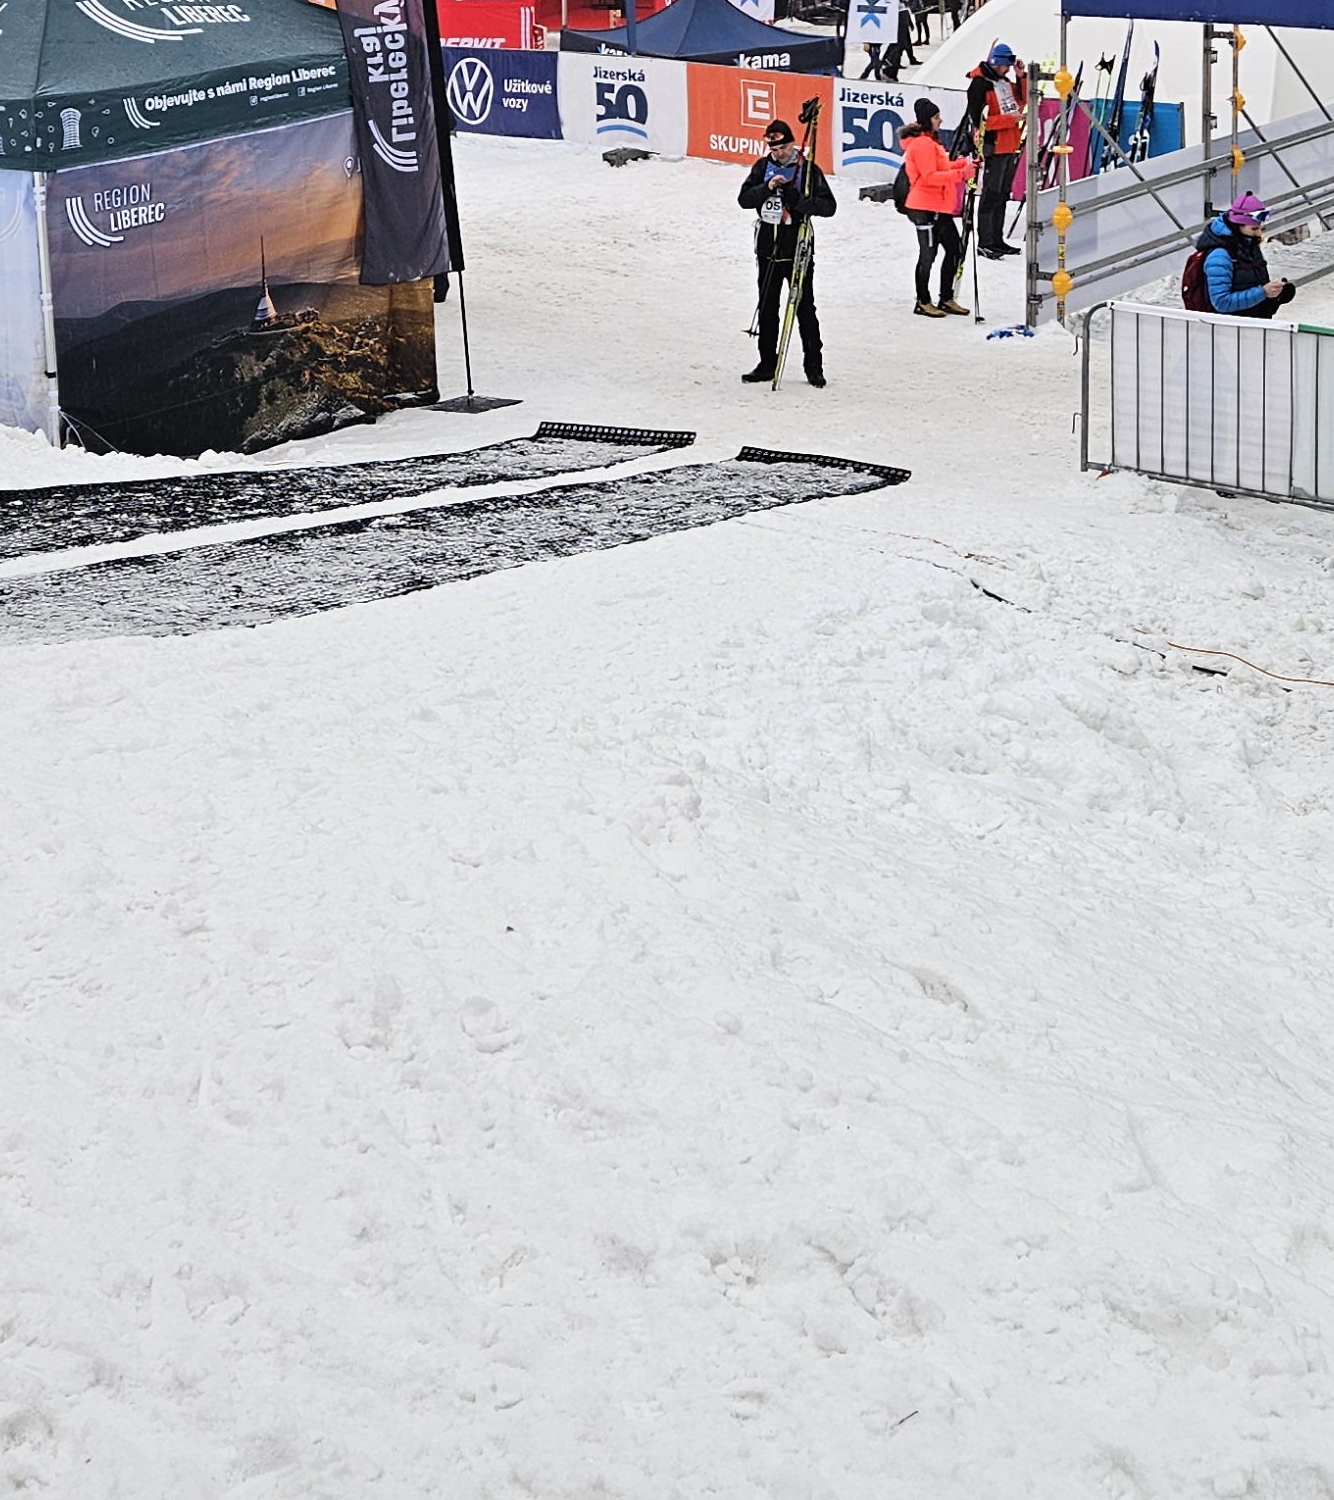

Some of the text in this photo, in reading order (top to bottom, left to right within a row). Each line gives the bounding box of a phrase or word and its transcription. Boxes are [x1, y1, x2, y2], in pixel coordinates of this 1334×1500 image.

[160, 4, 251, 26] LIBEREC
[738, 52, 791, 69] kama
[593, 66, 646, 82] Jizerská
[144, 64, 337, 112] Objevujte s námi Region Liberec
[503, 79, 552, 95] Užitkové
[839, 87, 905, 108] Jizerská
[502, 97, 529, 112] vozy
[595, 82, 649, 126] 50
[841, 105, 905, 157] 50
[94, 182, 151, 212] REGION
[109, 202, 165, 232] LIBEREC
